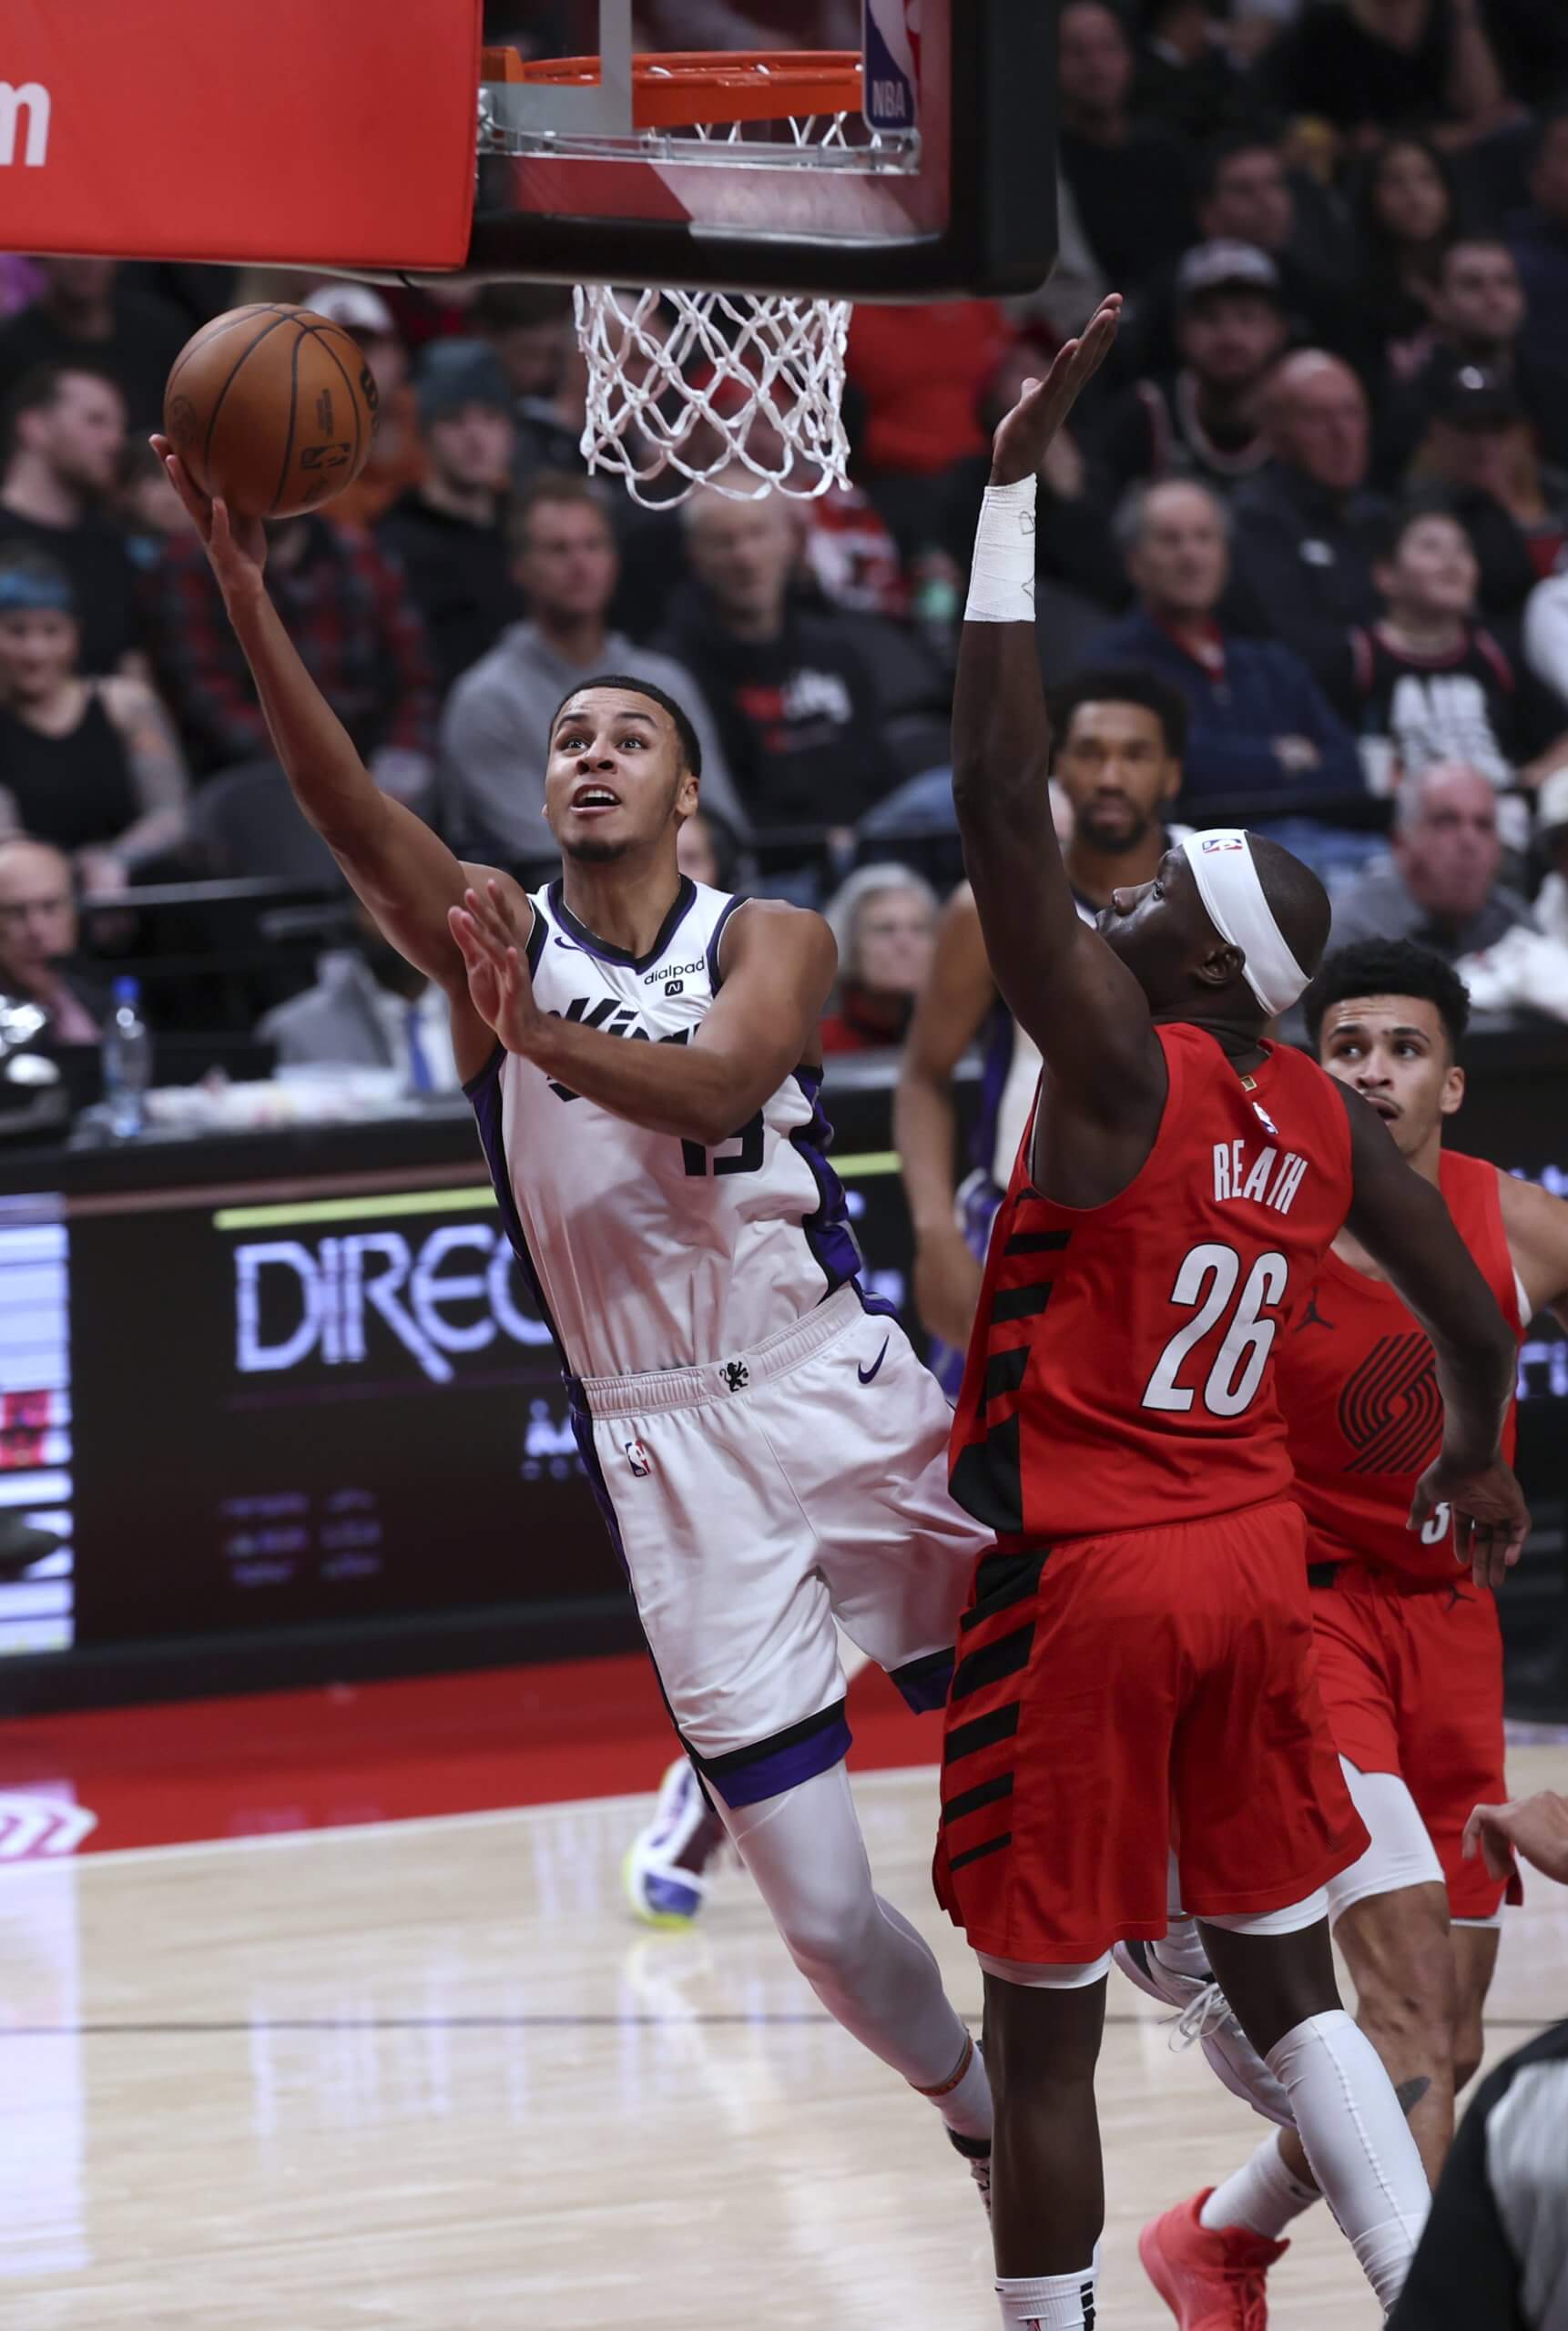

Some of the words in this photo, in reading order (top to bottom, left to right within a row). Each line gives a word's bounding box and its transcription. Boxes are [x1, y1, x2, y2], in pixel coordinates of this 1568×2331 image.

[872, 79, 905, 117] NBA
[643, 955, 705, 985] dialpad
[1213, 1139, 1308, 1216] REATH
[1141, 1241, 1289, 1418] 26
